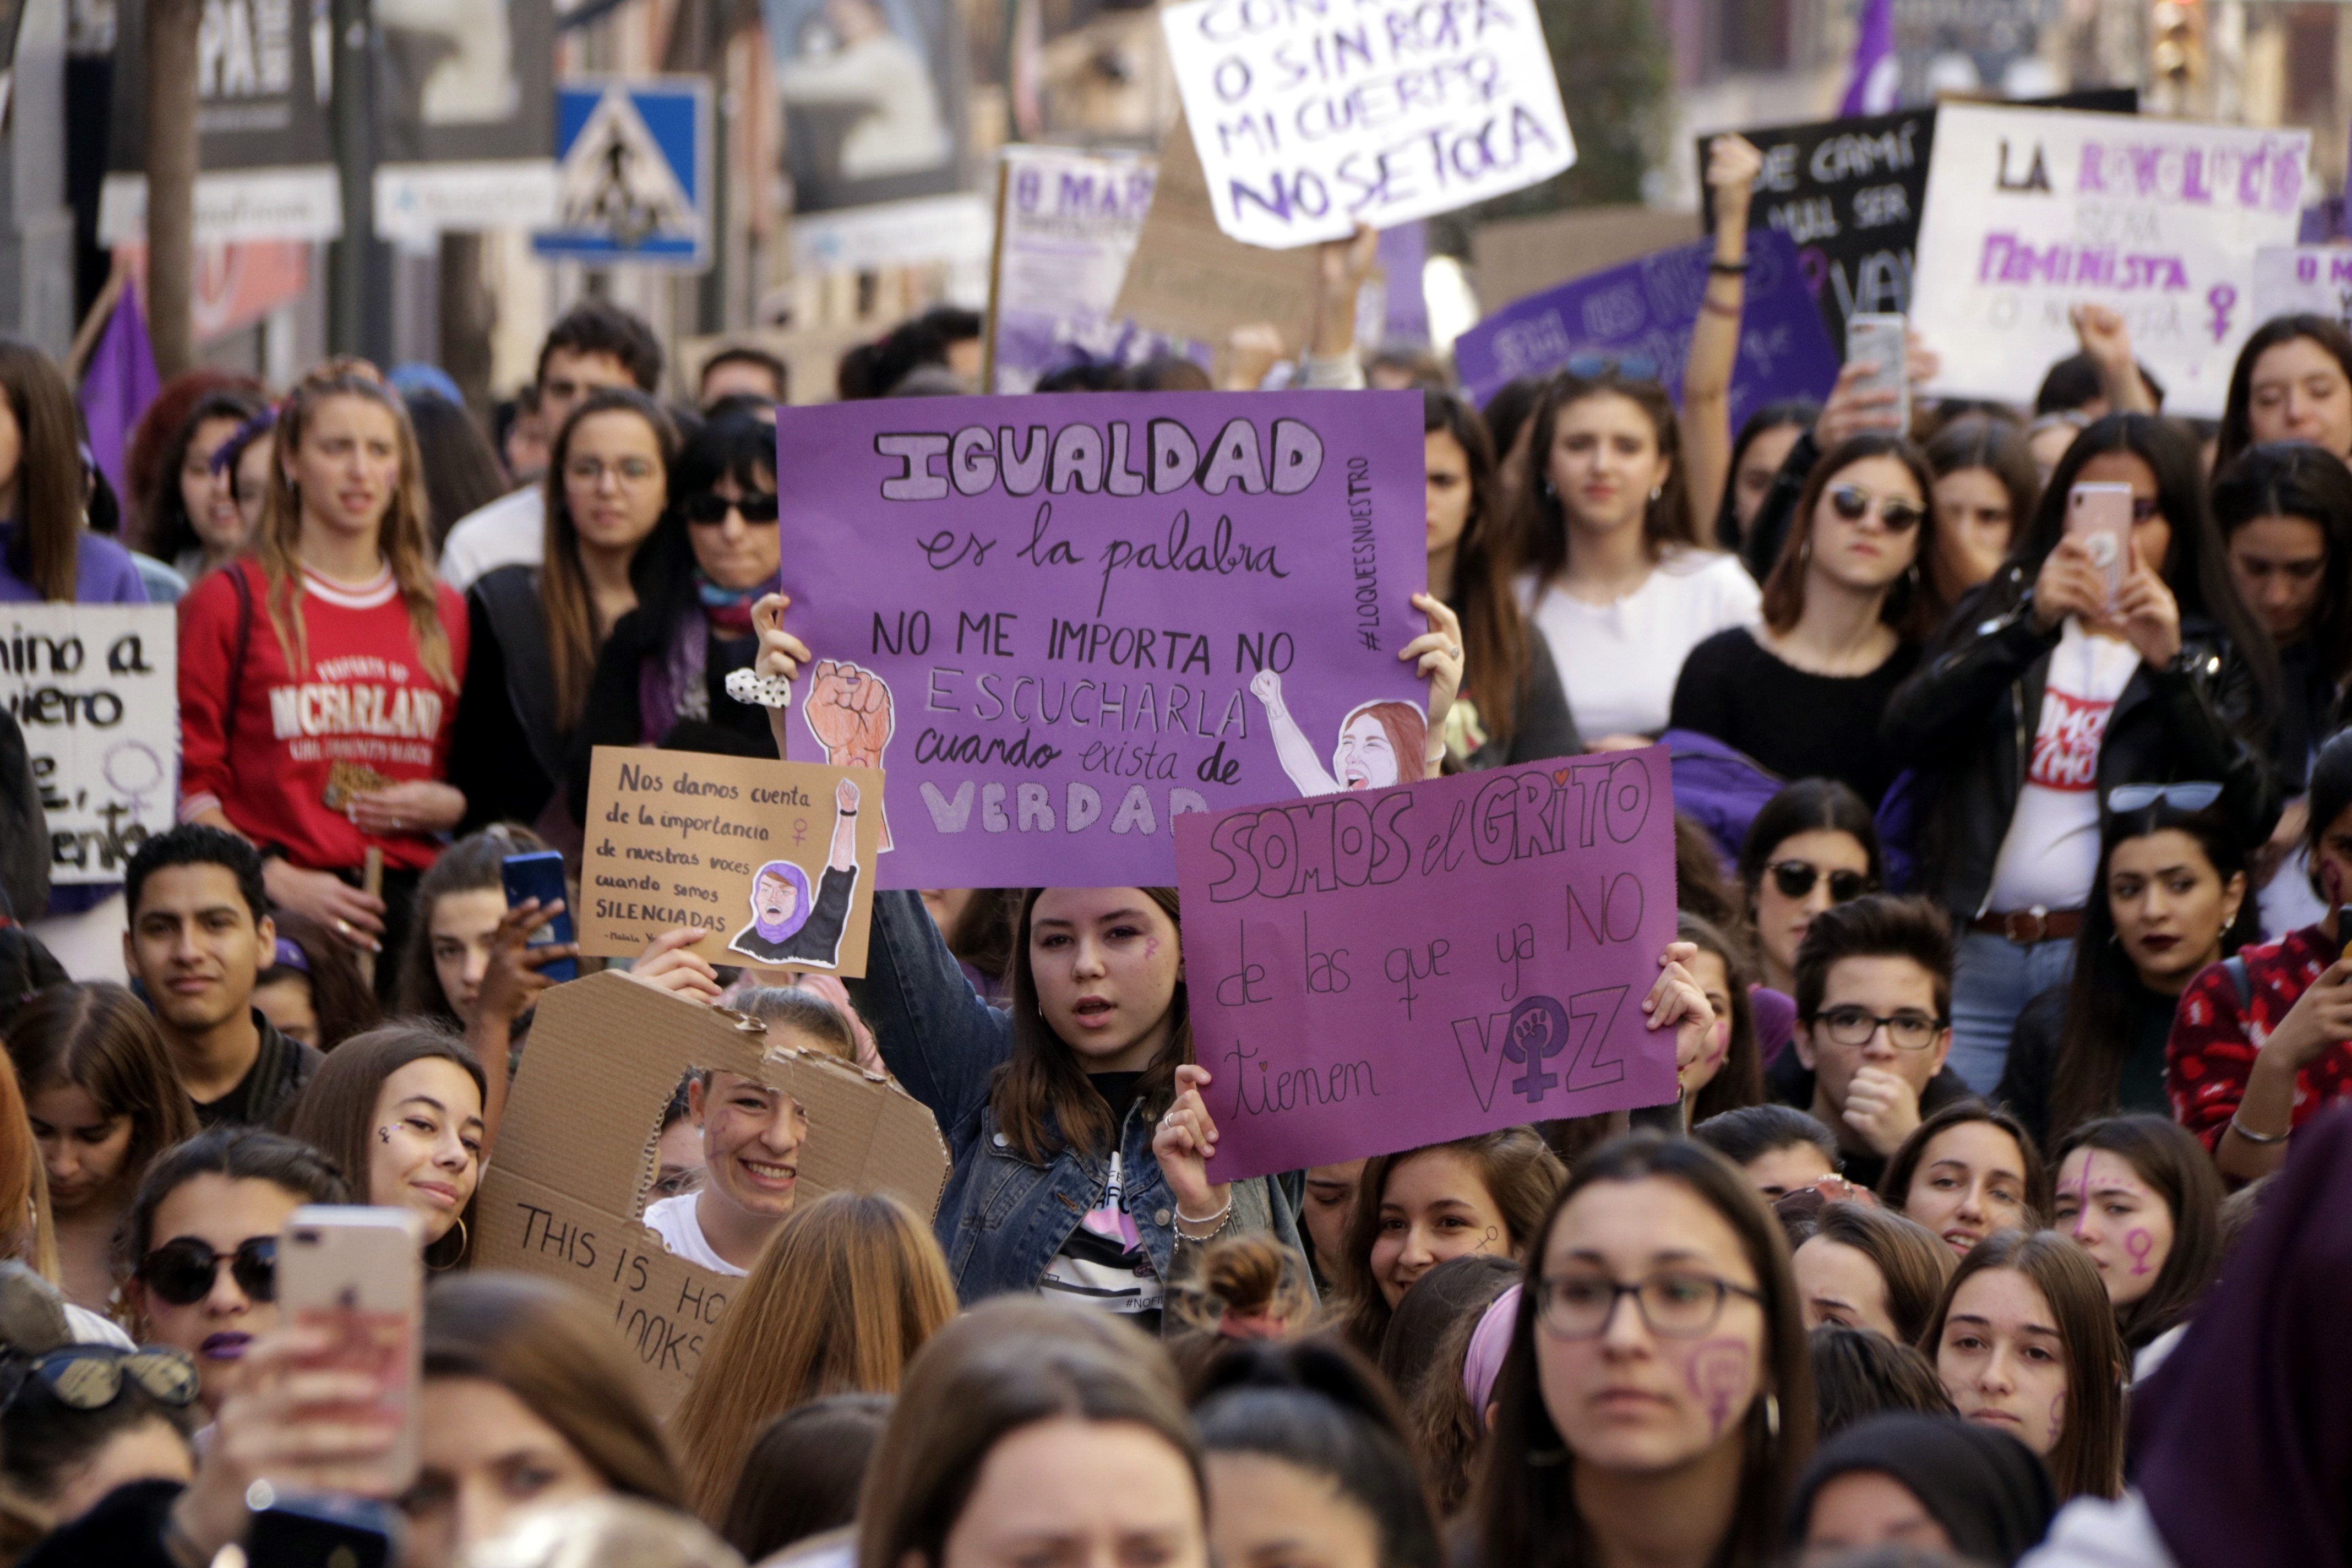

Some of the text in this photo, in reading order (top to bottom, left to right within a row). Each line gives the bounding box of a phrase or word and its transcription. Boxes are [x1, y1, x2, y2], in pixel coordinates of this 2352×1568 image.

[1212, 0, 1517, 106] O SIN ROPA
[1217, 107, 1281, 157] MI
[1228, 102, 1557, 225] NO SE TOCA
[1996, 138, 2054, 194] LA
[874, 417, 1324, 501] IGUALDAD
[917, 501, 1290, 618] es la palabra
[1347, 457, 1381, 652] #LOQUEESNUESTRO
[0, 622, 155, 676] ino a
[872, 611, 1294, 675] NO ME IMPORTA NO
[269, 681, 442, 742] MCFARLAND
[925, 666, 1247, 739] ESCUCHARLA
[618, 763, 811, 808] Nos damos cuenta
[914, 727, 1242, 786] cuando exista de
[606, 802, 769, 841] de la importancia
[1209, 791, 1414, 903] SOMOS
[1422, 799, 1465, 876] el
[595, 874, 718, 903] cuando somos
[596, 838, 750, 875] de nuestras voces
[596, 899, 726, 933] SILENCIADAS
[1216, 872, 1645, 1022] de las que ya NO
[1224, 1039, 1380, 1120] tienen
[517, 1202, 596, 1269] THIS
[613, 1248, 649, 1292] IS
